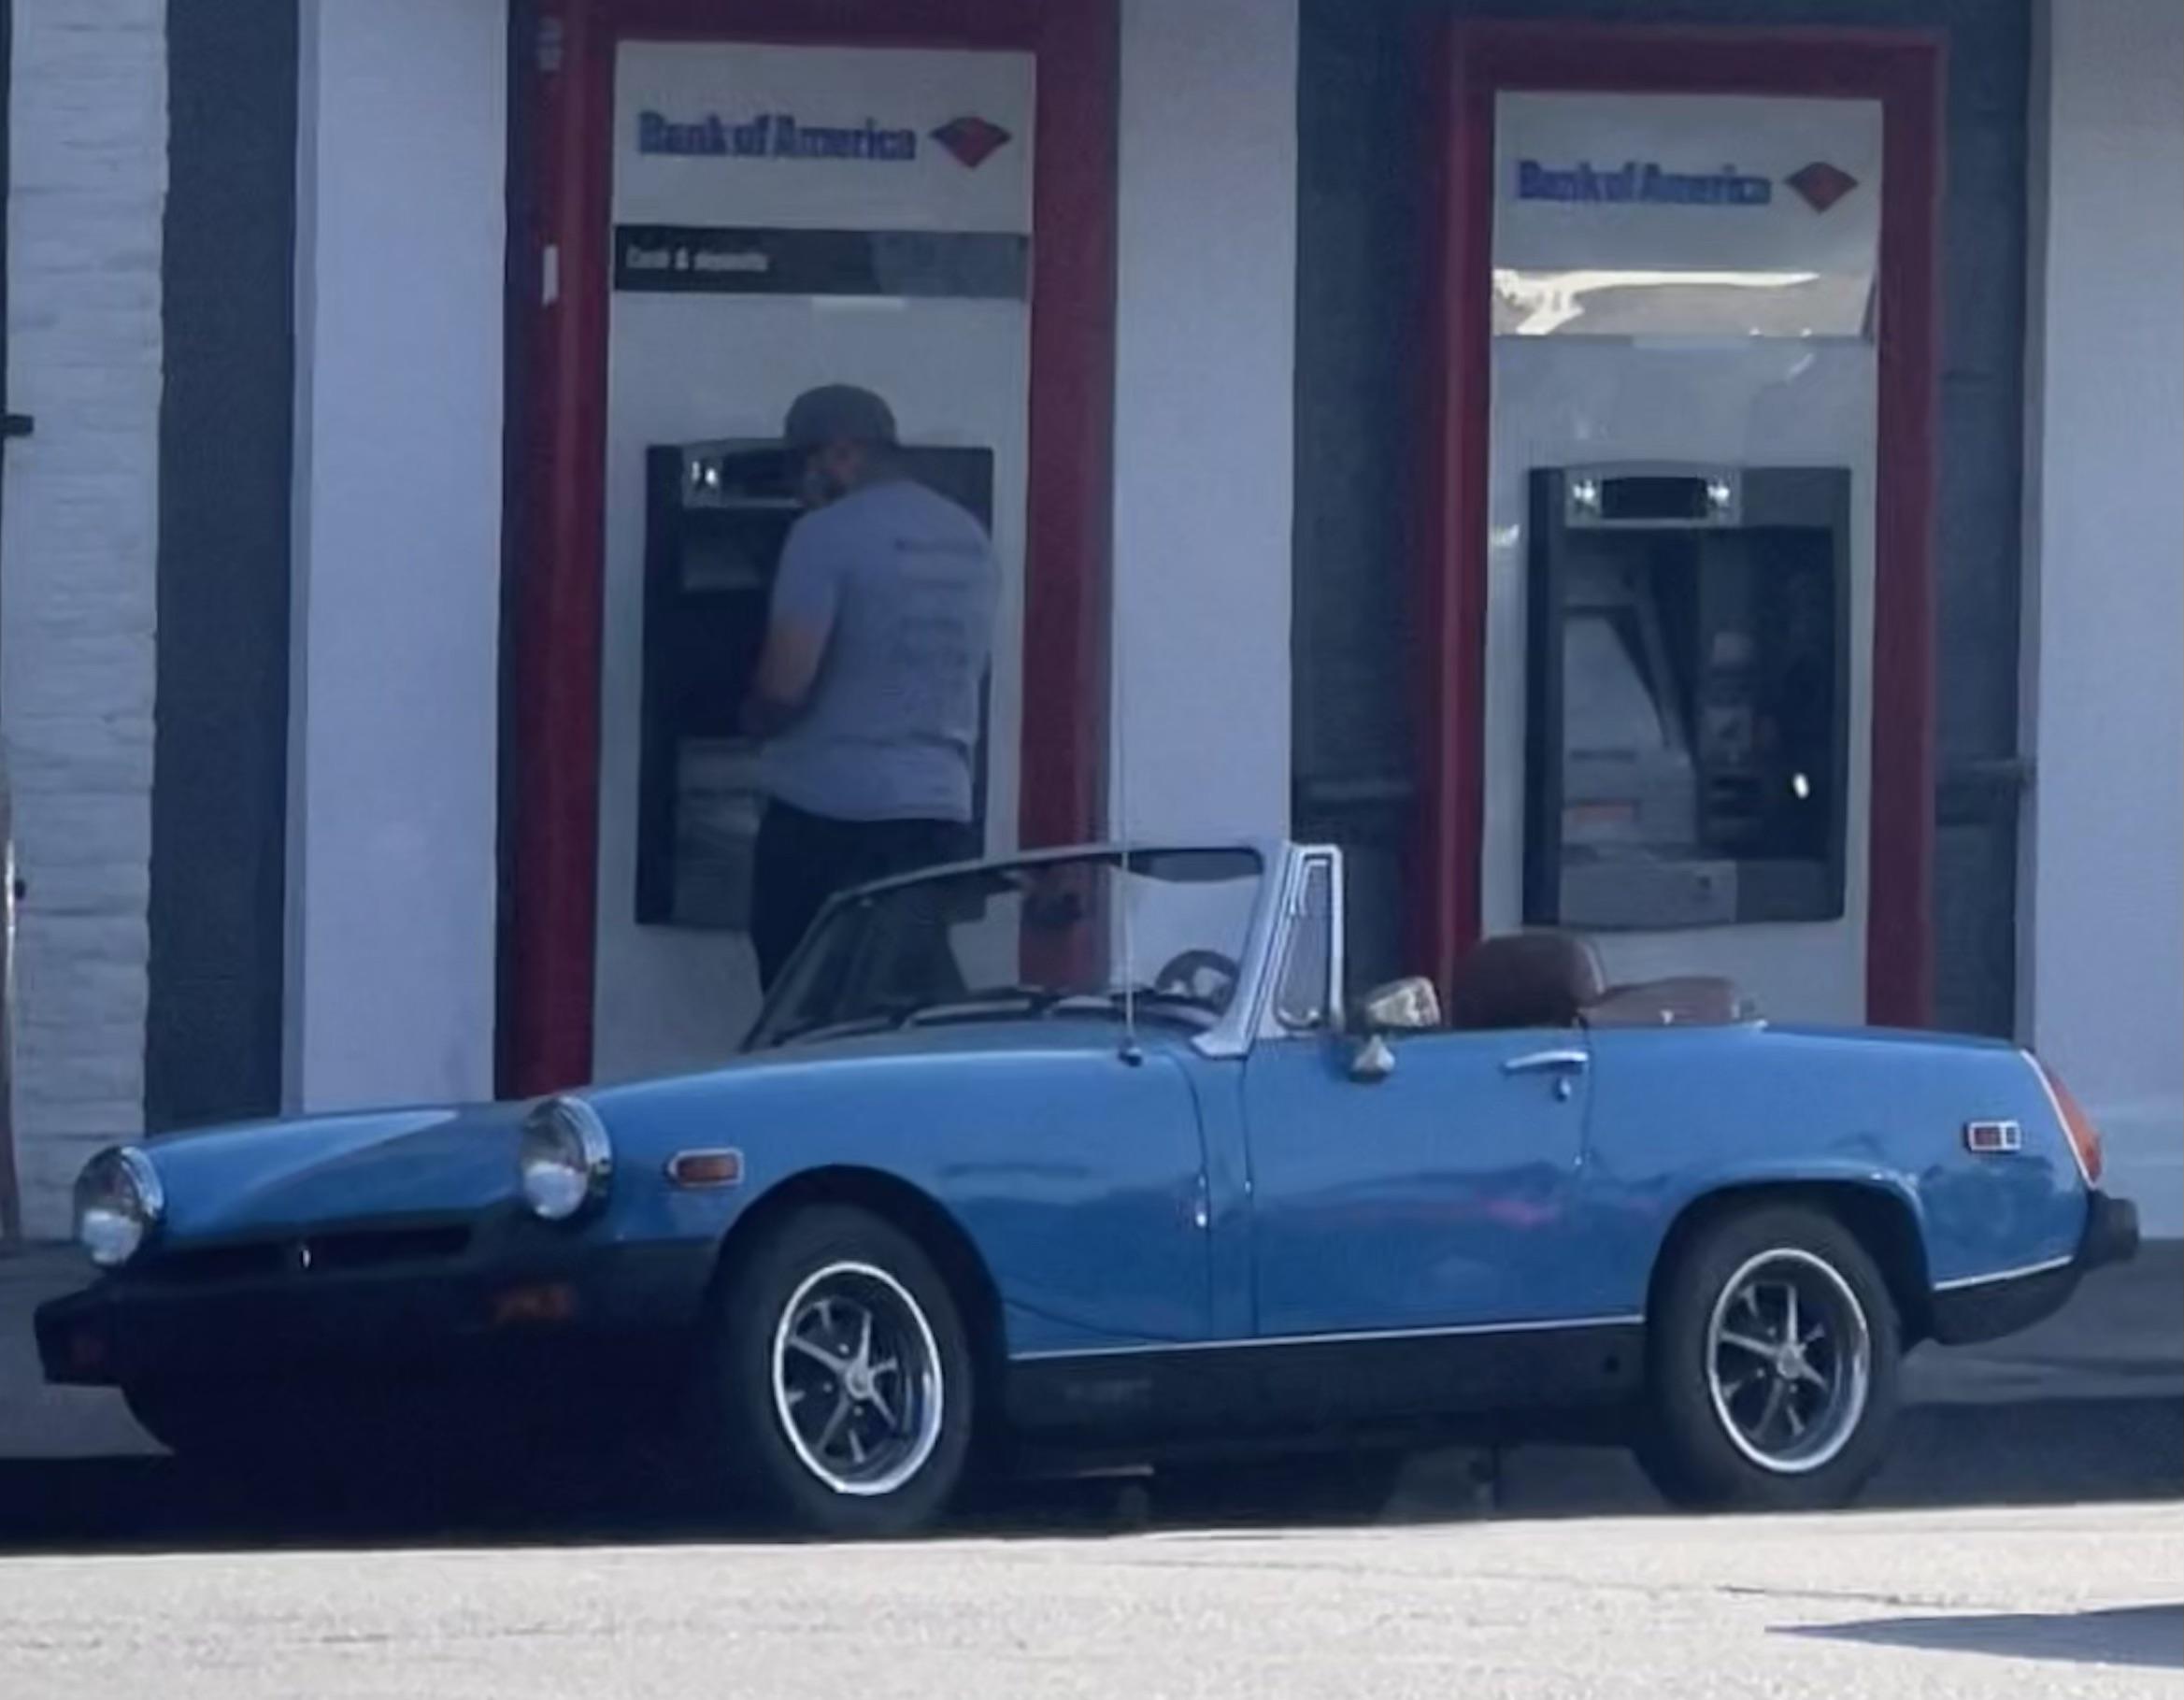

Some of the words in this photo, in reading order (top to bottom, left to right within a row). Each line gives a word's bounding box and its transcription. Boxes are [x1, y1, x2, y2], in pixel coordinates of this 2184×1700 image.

[639, 109, 726, 154] Bank
[773, 114, 916, 160] America
[1519, 160, 1598, 200] Bank
[1640, 162, 1772, 205] America
